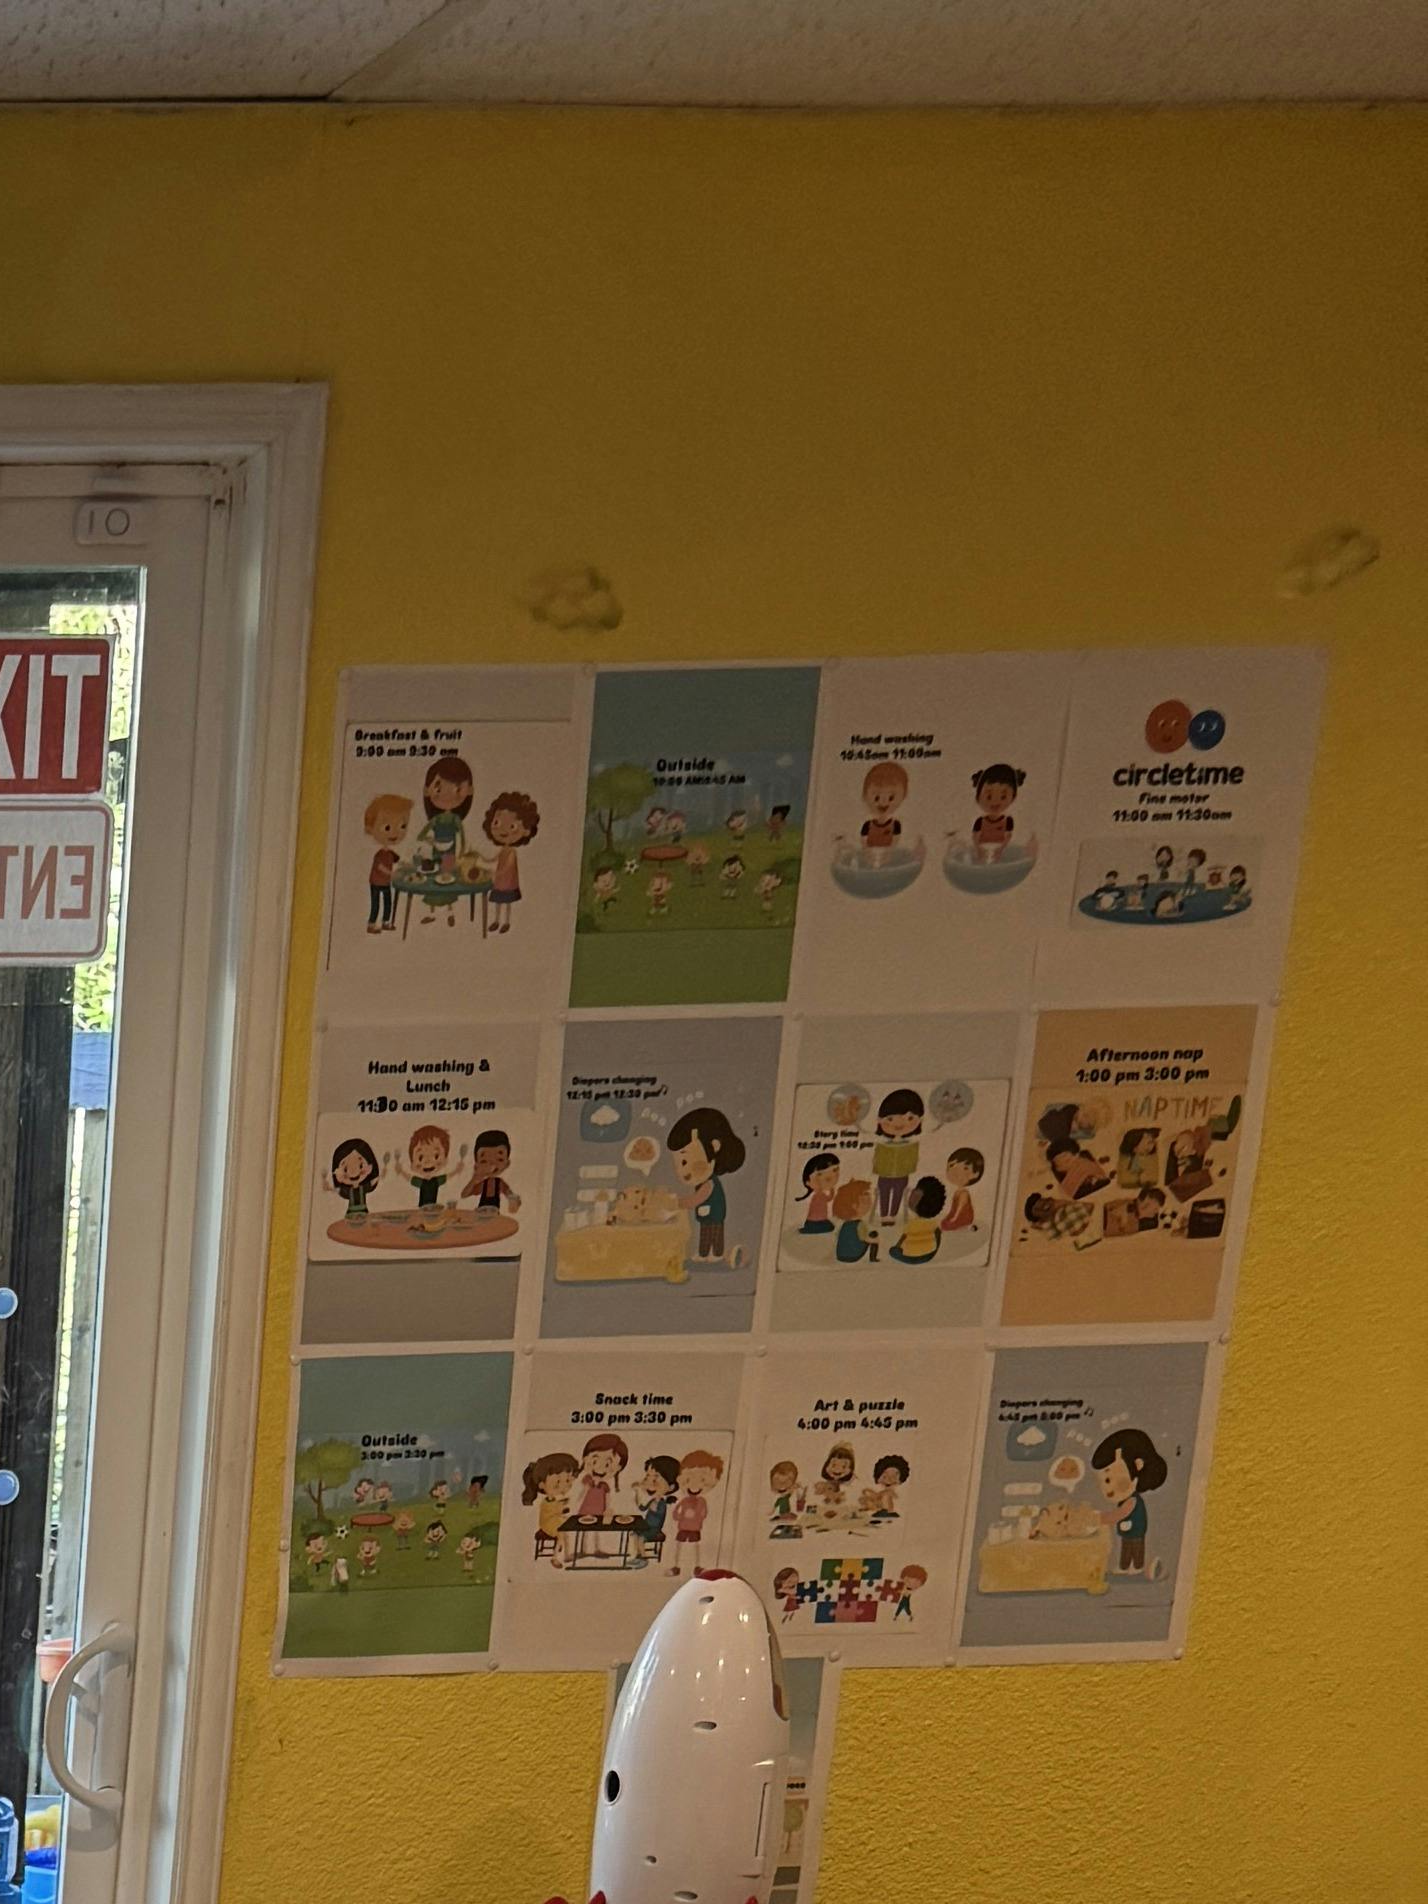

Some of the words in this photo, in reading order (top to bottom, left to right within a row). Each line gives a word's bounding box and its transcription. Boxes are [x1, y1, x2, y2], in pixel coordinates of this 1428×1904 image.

[354, 729, 417, 741] Breakfast
[434, 729, 463, 741] fruit
[850, 733, 882, 745] Hand
[884, 733, 934, 746] washing
[656, 757, 715, 772] Outside
[1112, 762, 1245, 787] circletime
[1139, 793, 1166, 805] Fine
[1086, 1048, 1169, 1063] Afternoon
[1173, 1048, 1204, 1064] nap
[367, 1060, 408, 1075] Hand
[411, 1059, 475, 1076] washing
[479, 1058, 491, 1073] &
[1076, 1069, 1111, 1084] 1:00
[1115, 1070, 1140, 1086] pm
[1144, 1066, 1182, 1081] 3:00
[1184, 1068, 1210, 1084] pm
[406, 1079, 451, 1094] Lunch
[402, 1101, 425, 1112] am
[473, 1100, 496, 1115] pm
[595, 1393, 638, 1406] Snack
[642, 1393, 674, 1406] time
[814, 1399, 839, 1412] Art
[843, 1399, 854, 1411] &
[858, 1398, 905, 1415] puzzle
[571, 1411, 604, 1424] 3:00
[607, 1413, 631, 1427] pm
[634, 1411, 666, 1424] 3:30
[669, 1413, 692, 1427] pm
[797, 1418, 830, 1430] 4:00
[833, 1419, 856, 1432] pm
[860, 1416, 892, 1429] 4:45
[895, 1419, 918, 1432] pm
[361, 1433, 418, 1447] Outside
